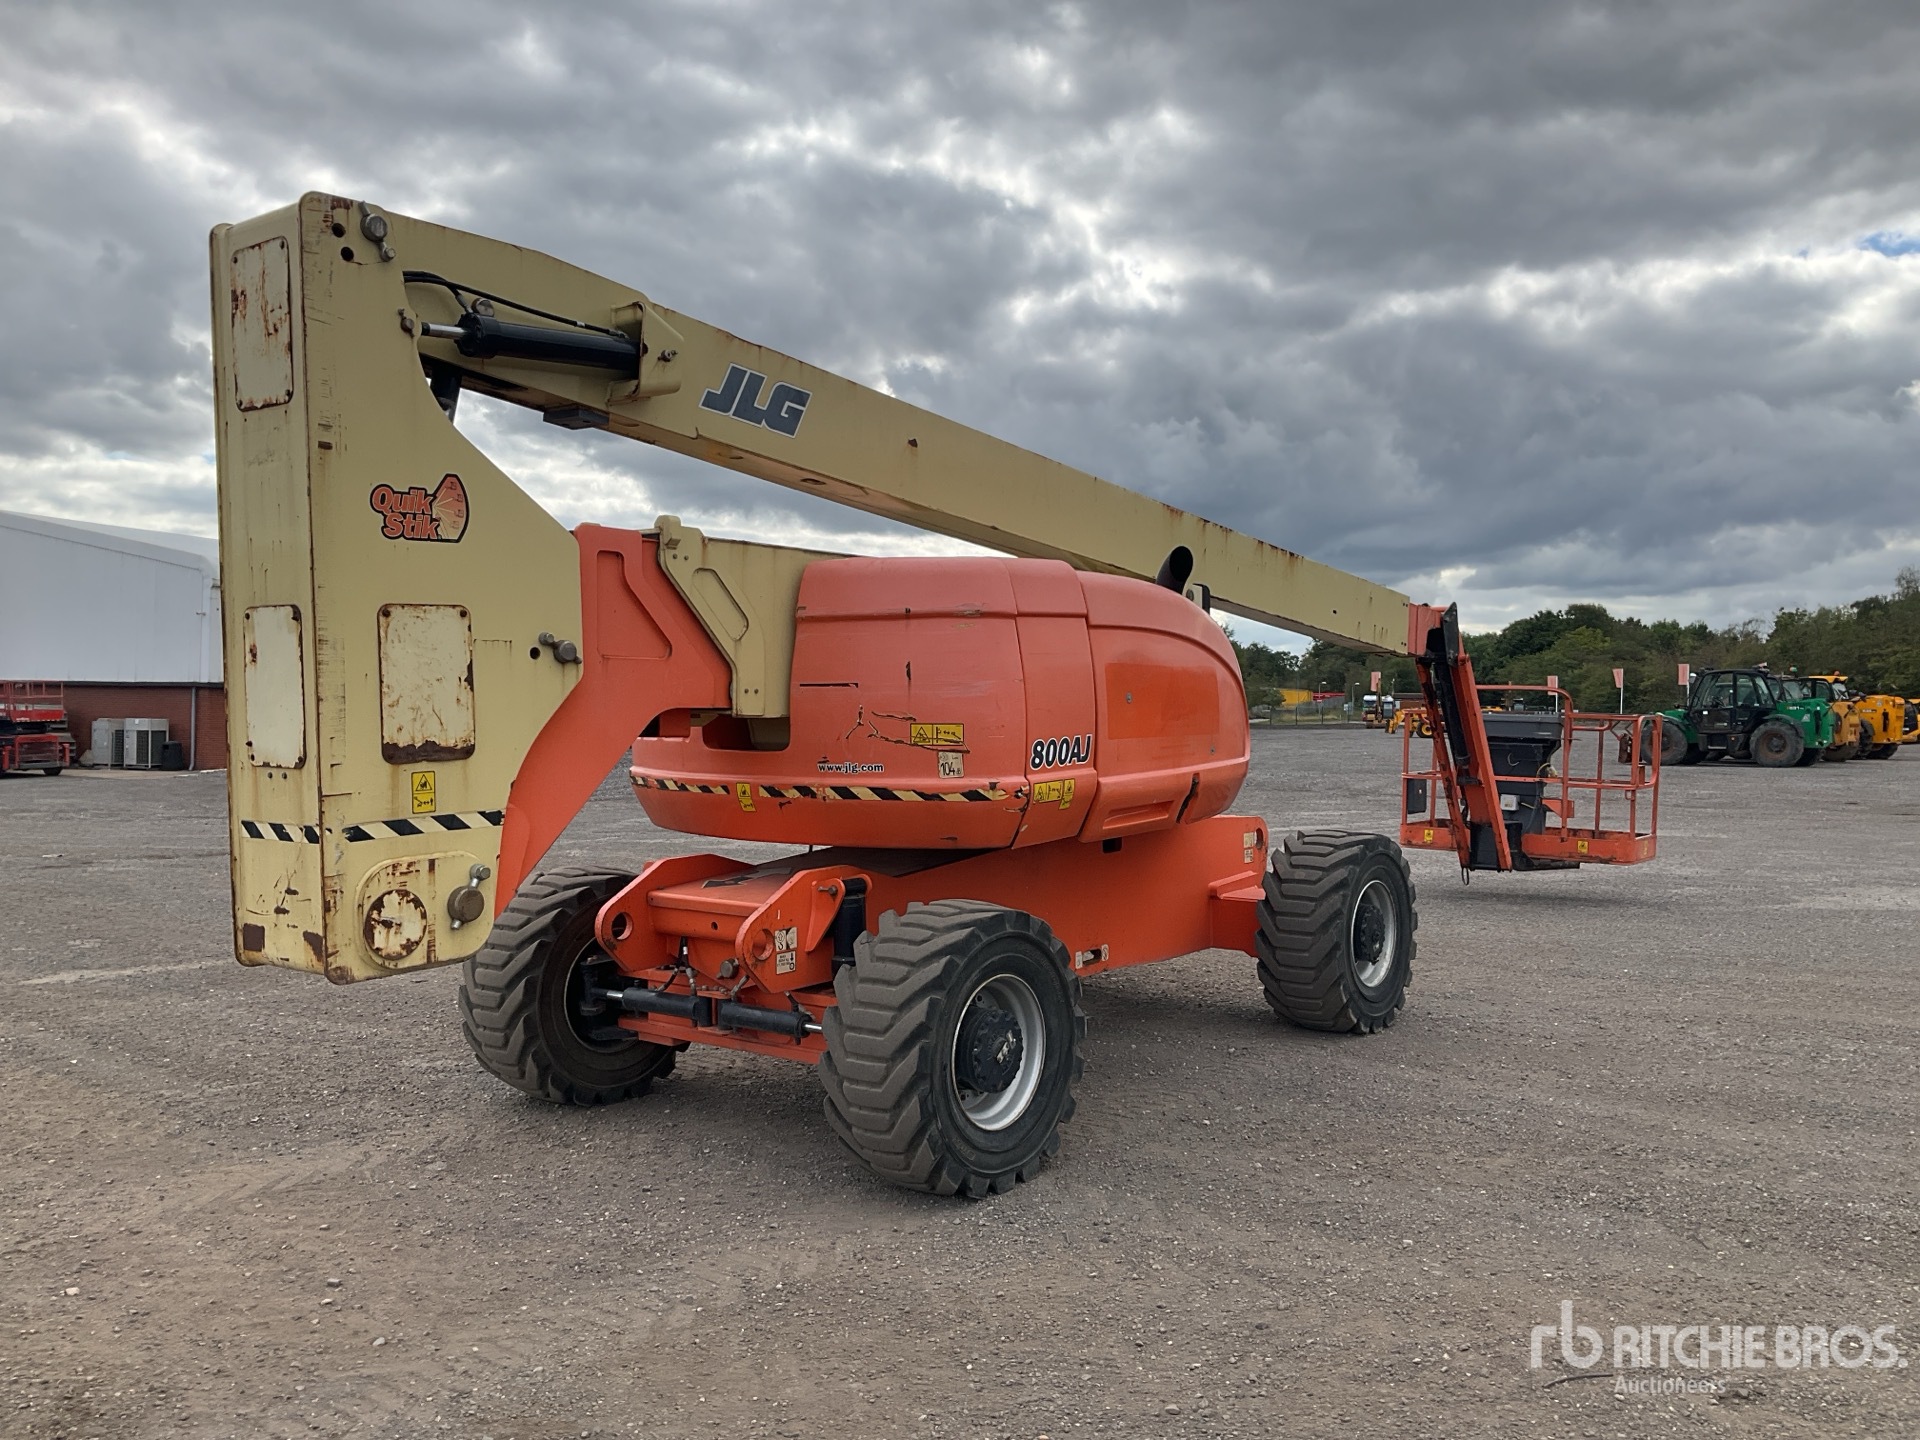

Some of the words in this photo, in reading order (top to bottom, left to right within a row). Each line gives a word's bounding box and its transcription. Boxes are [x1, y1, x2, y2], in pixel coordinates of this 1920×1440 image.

[699, 363, 812, 438] JLG
[371, 485, 433, 515] Quik
[383, 512, 439, 539] Stik
[1030, 734, 1092, 770] 800AJ
[817, 762, 884, 774] www.jlg.com
